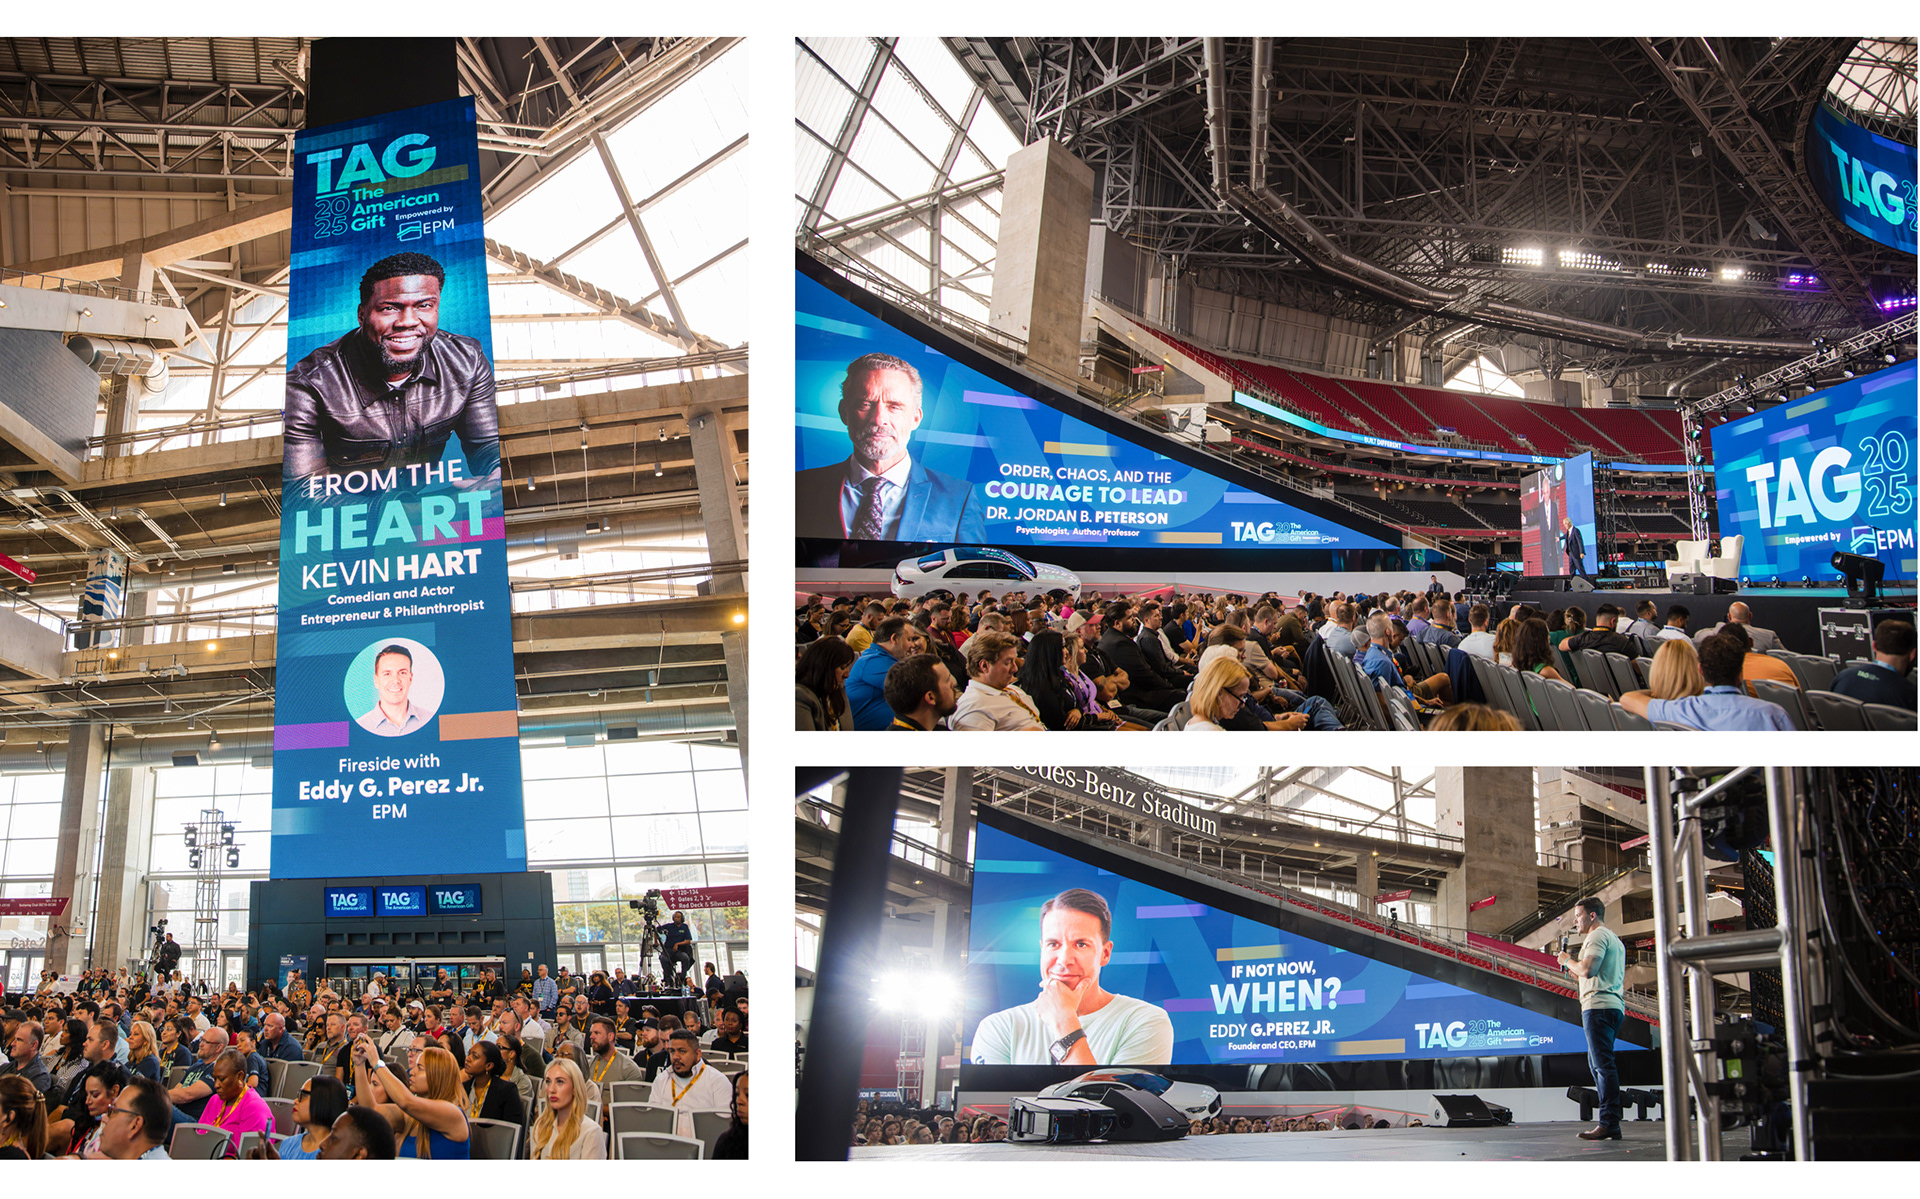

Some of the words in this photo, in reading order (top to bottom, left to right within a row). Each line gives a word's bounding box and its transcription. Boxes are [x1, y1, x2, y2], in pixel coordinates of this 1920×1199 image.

[307, 133, 436, 195] TAG
[1830, 140, 1905, 226] TAG
[352, 187, 384, 202] The
[1901, 180, 1918, 206] 2
[315, 197, 350, 220] 20
[352, 191, 439, 217] American
[395, 207, 442, 221] Empowered
[443, 205, 454, 218] by
[314, 216, 348, 239] 25
[351, 214, 386, 232] Gift
[423, 218, 455, 234] EPM
[1859, 430, 1909, 476] 20
[308, 466, 397, 498] FROM
[406, 459, 463, 487] THE
[999, 463, 1053, 480] ORDER,
[1056, 467, 1111, 483] CHAOS,
[1113, 470, 1144, 483] AND
[1147, 471, 1172, 484] THE
[985, 480, 1093, 502] COURAGE
[1099, 486, 1126, 504] TO
[1131, 488, 1183, 505] LEAD
[1746, 446, 1862, 529] TAG
[1864, 473, 1913, 517] 25
[295, 489, 491, 554] HEART
[986, 506, 1011, 520] DR.
[1014, 508, 1077, 522] JORDAN
[1080, 510, 1093, 523] B.
[1095, 511, 1168, 525] PETERSON
[1016, 526, 1069, 536] Psychologist,
[1072, 527, 1102, 536] Author,
[1103, 528, 1140, 537] Professor
[1231, 522, 1275, 541] TAG
[1276, 522, 1290, 532] 20
[1785, 532, 1829, 545] Empowered
[1831, 532, 1841, 543] by
[1877, 528, 1914, 550] EPM
[302, 557, 390, 590] KEVIN
[397, 548, 482, 581] HART
[327, 590, 391, 605] Comedian
[393, 587, 418, 600] and
[420, 586, 455, 597] Actor
[300, 609, 380, 626] Entrepreneur
[383, 608, 392, 618] &
[395, 600, 484, 618] Philanthropist
[339, 756, 400, 773] Fireside
[404, 753, 440, 769] with
[299, 780, 354, 803] Eddy
[359, 778, 383, 798] G.
[388, 777, 450, 796] Perez
[456, 772, 485, 793] Jr.
[372, 803, 407, 819] EPM
[1142, 792, 1218, 837] Stadium
[331, 893, 358, 906] TAG
[382, 892, 410, 905] TAG
[435, 891, 465, 904] TAG
[11, 937, 38, 949] Gate
[39, 937, 46, 949] 2
[1231, 965, 1243, 978] IF
[1246, 963, 1275, 978] NOT
[1277, 960, 1316, 976] NOW,
[1210, 976, 1342, 1014] WHEN?
[1210, 1023, 1248, 1038] EDDY
[1250, 1021, 1309, 1037] G.PEREZ
[1312, 1020, 1335, 1035] JR.
[1468, 1020, 1486, 1034] 20
[1487, 1020, 1501, 1028] The
[1487, 1028, 1525, 1036] American
[1415, 1021, 1468, 1049] TAG
[1469, 1034, 1486, 1047] 25
[1487, 1037, 1502, 1046] Gift
[1228, 1042, 1260, 1050] Founder
[1262, 1041, 1277, 1050] and
[1278, 1040, 1298, 1050] CEO,
[1299, 1040, 1316, 1049] EPM
